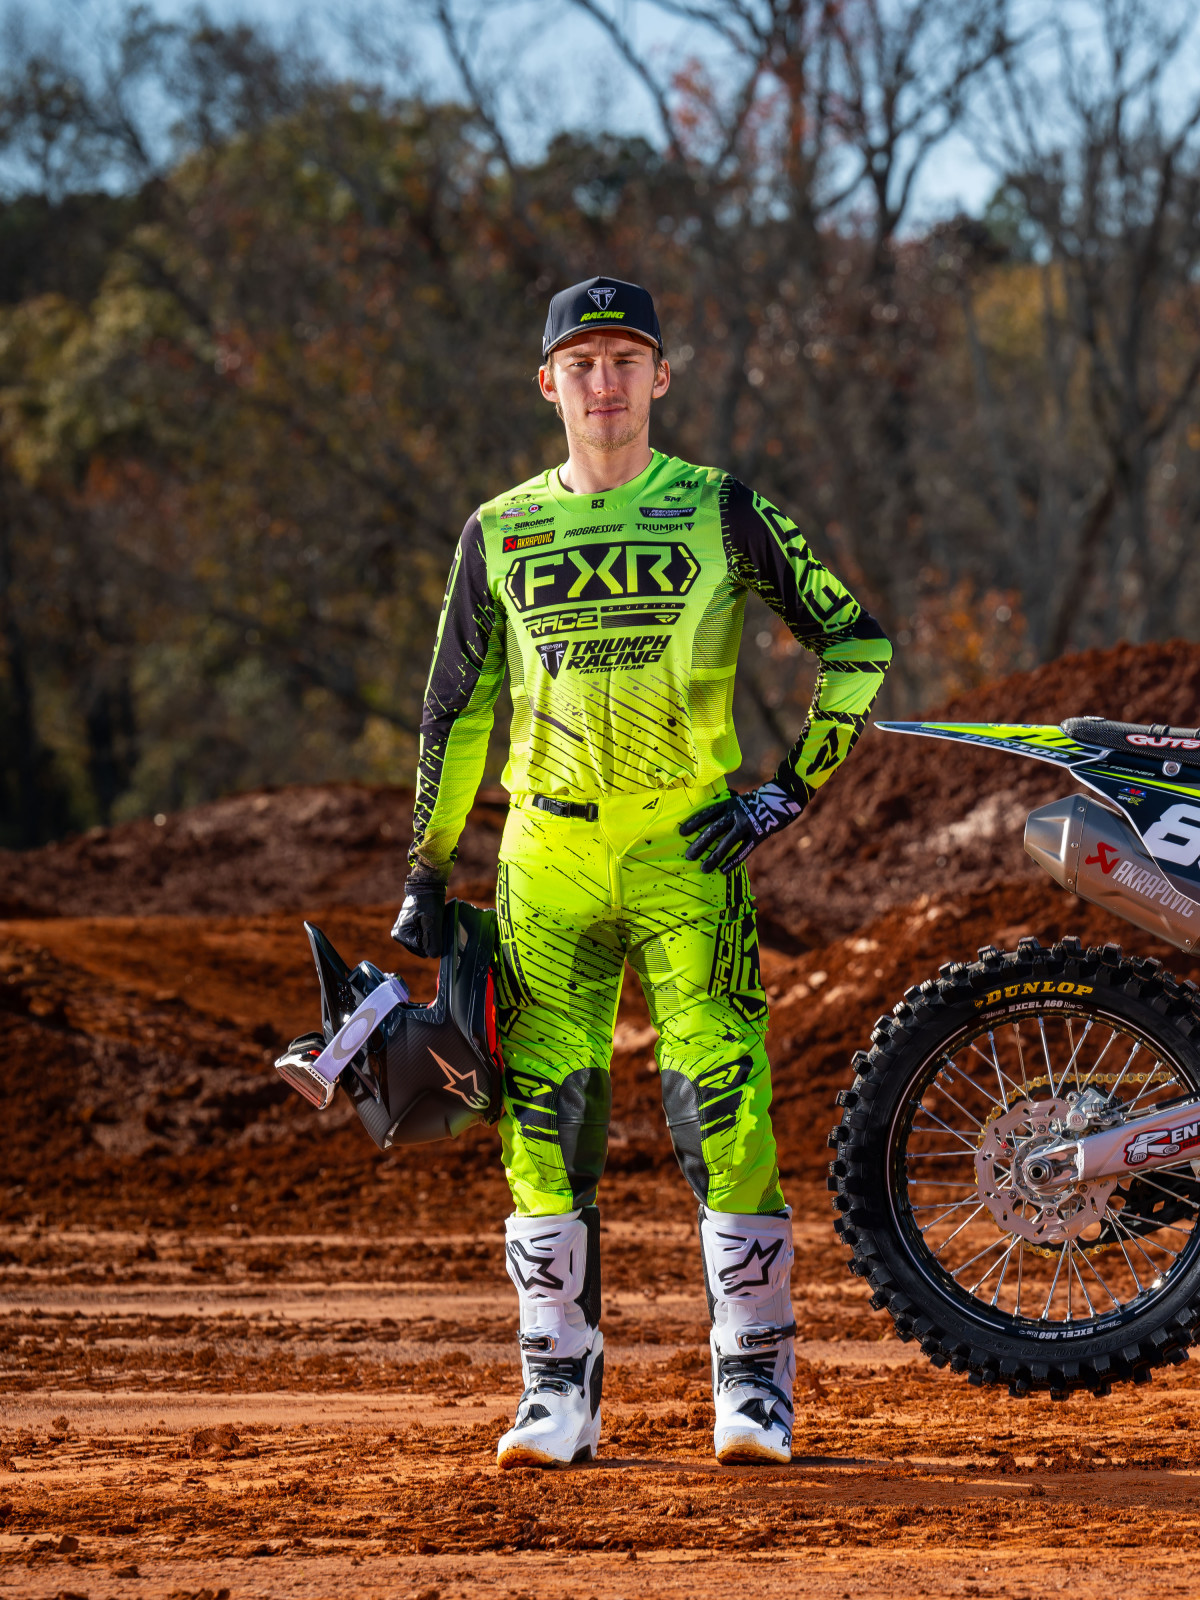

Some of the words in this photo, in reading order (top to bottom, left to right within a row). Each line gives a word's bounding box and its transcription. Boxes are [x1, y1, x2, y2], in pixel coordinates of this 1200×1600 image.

[580, 311, 625, 322] RACING
[591, 499, 605, 509] 83
[513, 517, 555, 530] Silkolene
[635, 523, 683, 533] TRIUMPH
[563, 523, 627, 539] PROGRESSIVE
[525, 545, 674, 607] FXR
[526, 611, 599, 636] RACE
[571, 634, 673, 656] TRIUMPH
[565, 649, 665, 671] RACING
[579, 665, 620, 675] FACTORY
[621, 663, 646, 672] TEAM
[958, 733, 1070, 759] DUNLOP
[1109, 764, 1156, 777] FORKNER
[985, 981, 1094, 1006] DUNLOP
[1008, 1001, 1042, 1013] EXCEL
[1043, 1000, 1064, 1008] A60
[1060, 1327, 1094, 1339] EXCEL
